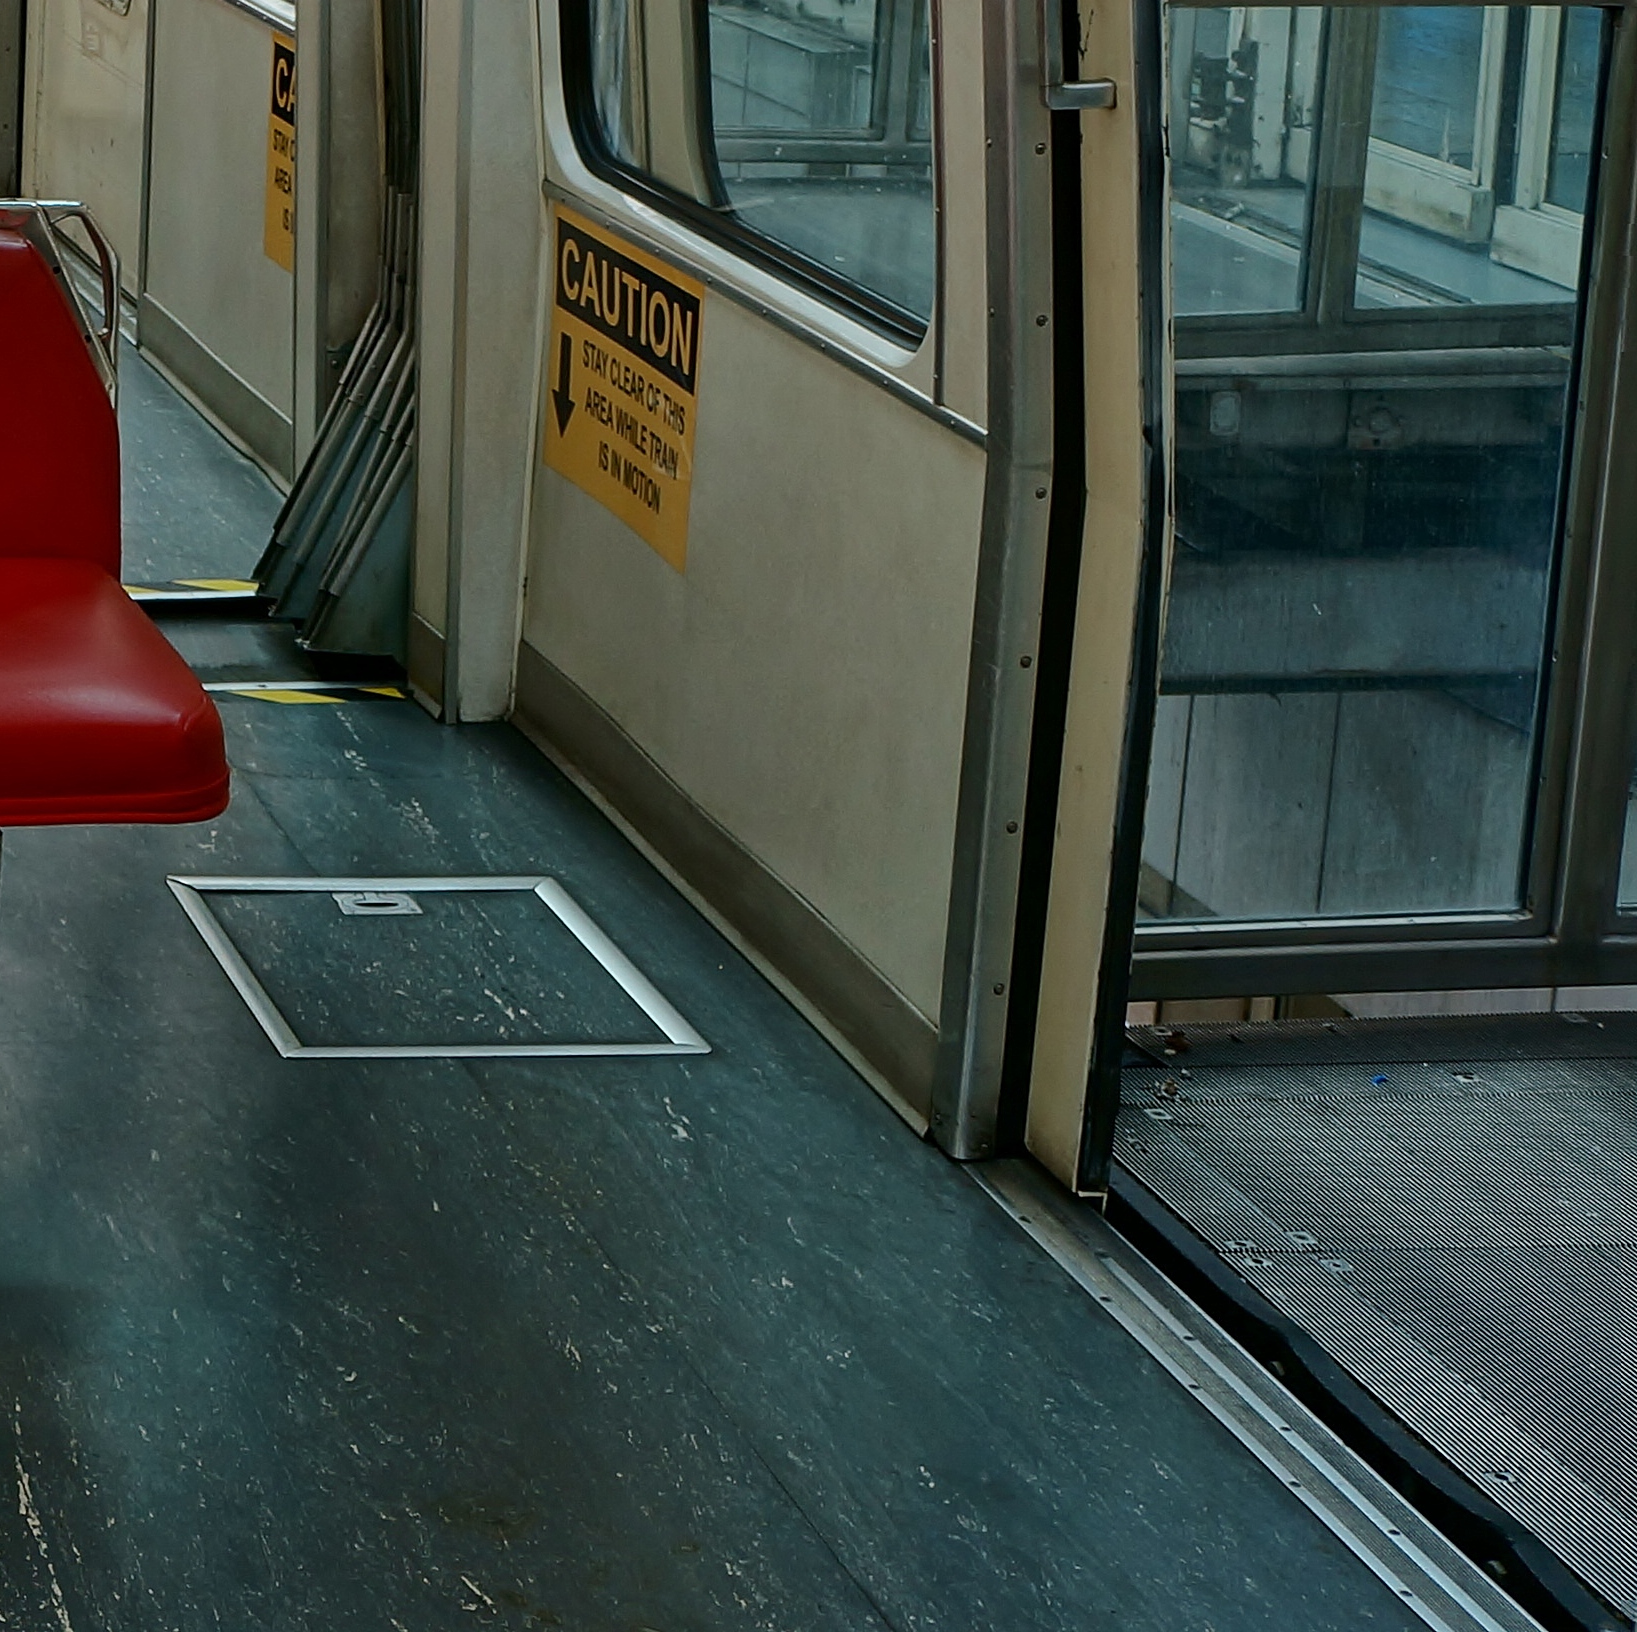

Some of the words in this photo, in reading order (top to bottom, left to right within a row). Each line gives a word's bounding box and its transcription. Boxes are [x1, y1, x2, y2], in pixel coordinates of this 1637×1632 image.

[561, 238, 693, 376] CAUTION
[582, 339, 609, 380] STAY
[610, 356, 644, 407] CLEAR
[646, 382, 661, 416] OF
[663, 392, 686, 437] THIS
[584, 386, 614, 431] AREA
[615, 404, 648, 456] WHILE
[649, 430, 679, 481] TRAIN
[598, 440, 609, 472] IS
[611, 448, 622, 483] IN
[623, 456, 661, 515] MOTION
